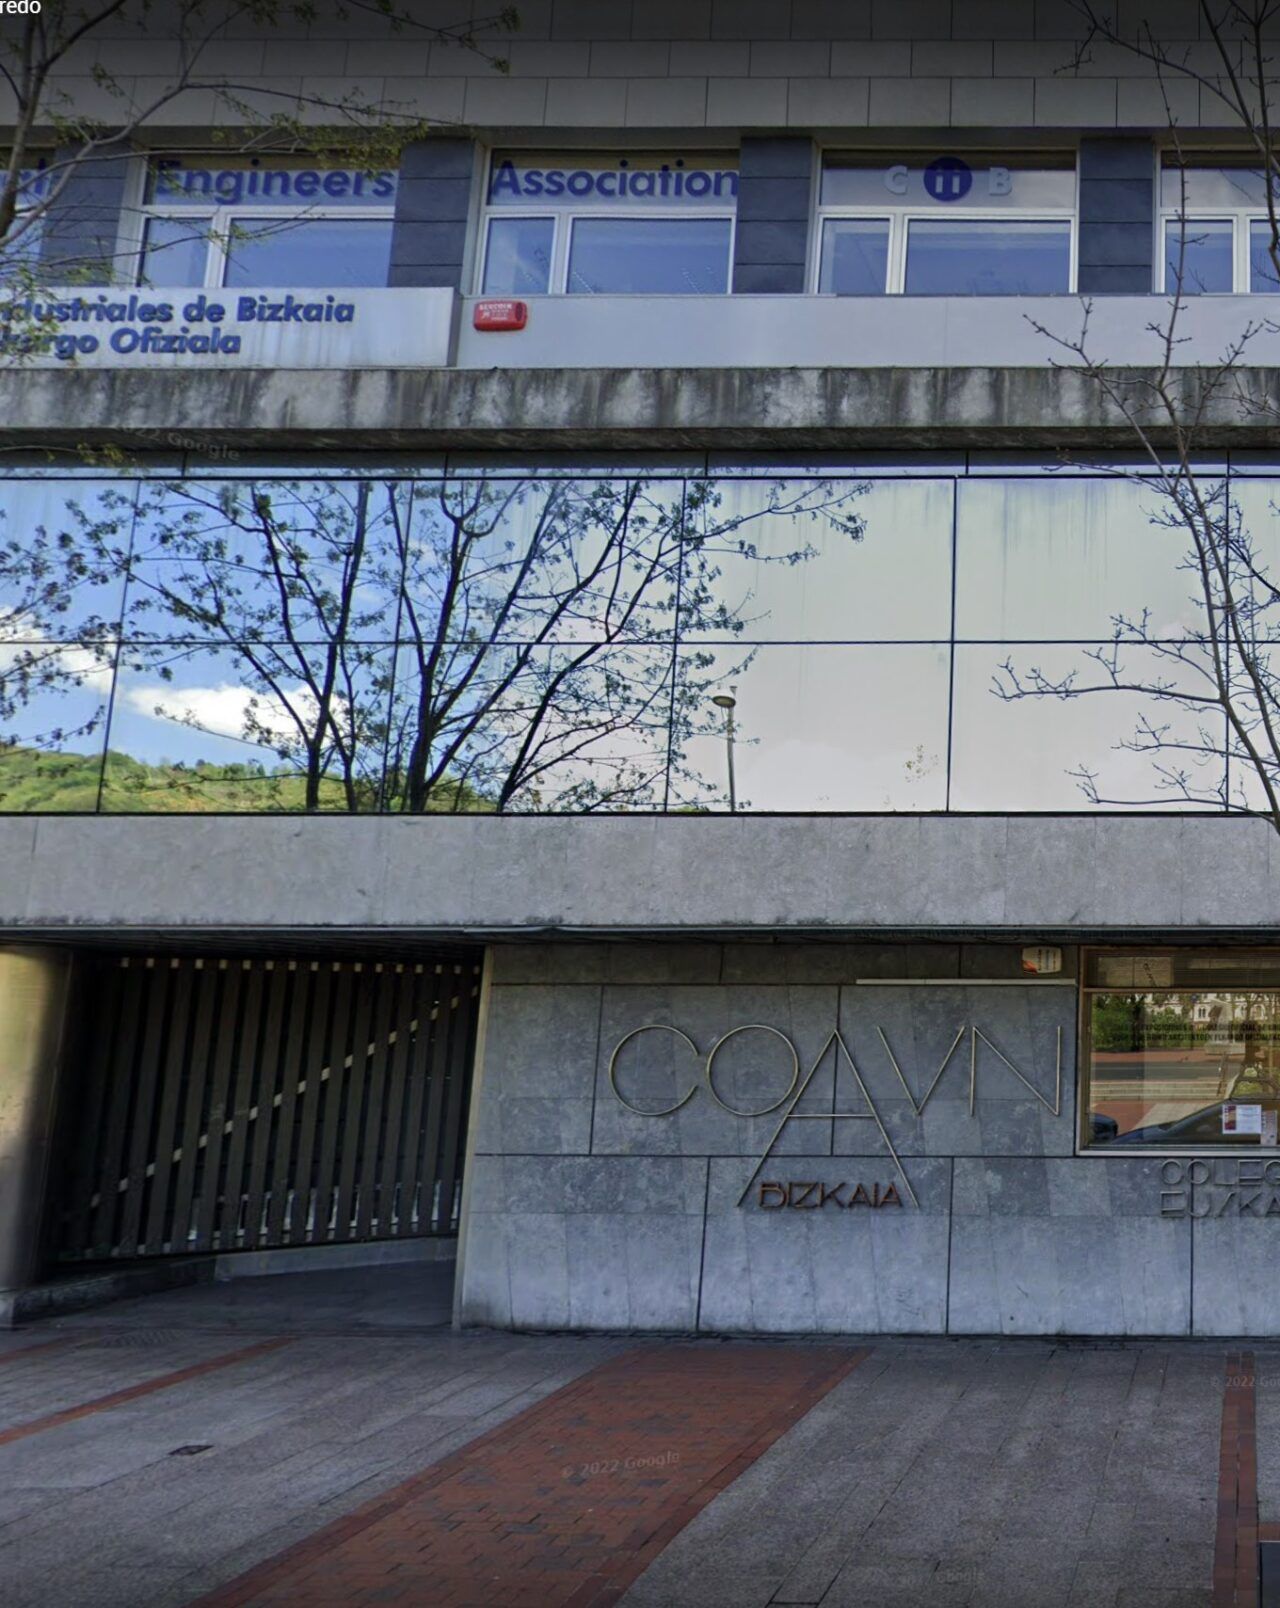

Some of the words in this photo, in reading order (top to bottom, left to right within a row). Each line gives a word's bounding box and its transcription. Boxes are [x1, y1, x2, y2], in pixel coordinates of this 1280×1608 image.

[156, 159, 395, 205] Engineers
[492, 159, 738, 197] Association
[182, 294, 226, 323] de
[236, 294, 356, 323] Bizkaia
[109, 326, 242, 355] Ofiziala
[607, 1024, 1062, 1208] COAVN
[757, 1181, 903, 1210] BIZKAIA
